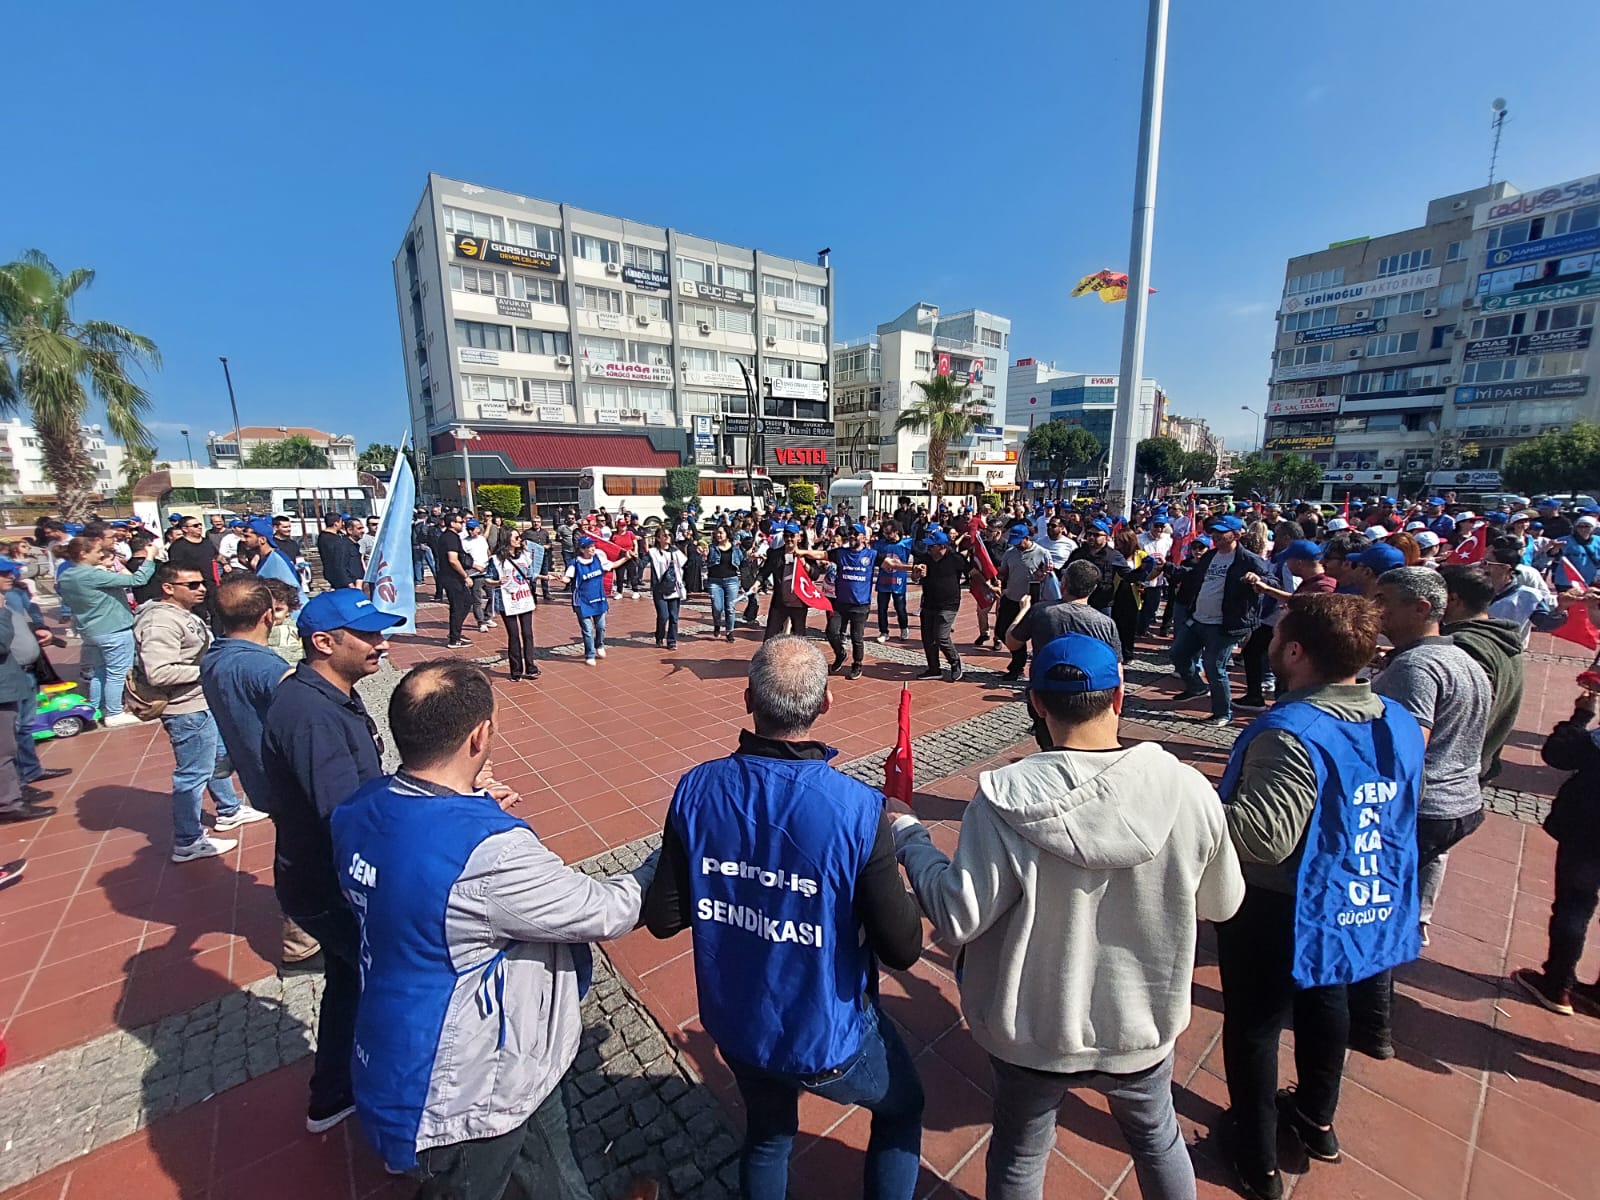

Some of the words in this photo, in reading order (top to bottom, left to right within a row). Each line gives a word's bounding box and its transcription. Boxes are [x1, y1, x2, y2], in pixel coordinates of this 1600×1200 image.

[529, 250, 557, 261] GRUP
[498, 299, 530, 308] AVUKAT
[1505, 285, 1579, 305] ETKİN
[1472, 340, 1509, 349] ARAS
[606, 363, 650, 374] ALİAĞA
[1495, 385, 1538, 399] PARTİ
[775, 447, 829, 465] VESTEL
[1472, 472, 1498, 480] QNB
[1352, 781, 1398, 806] SEN
[1355, 829, 1382, 854] KA
[349, 852, 377, 889] SEN
[702, 856, 818, 898] petrol-iş
[1348, 879, 1391, 907] OL
[697, 898, 823, 948] SENDİKASI
[1337, 907, 1376, 928] GÜÇLÜ
